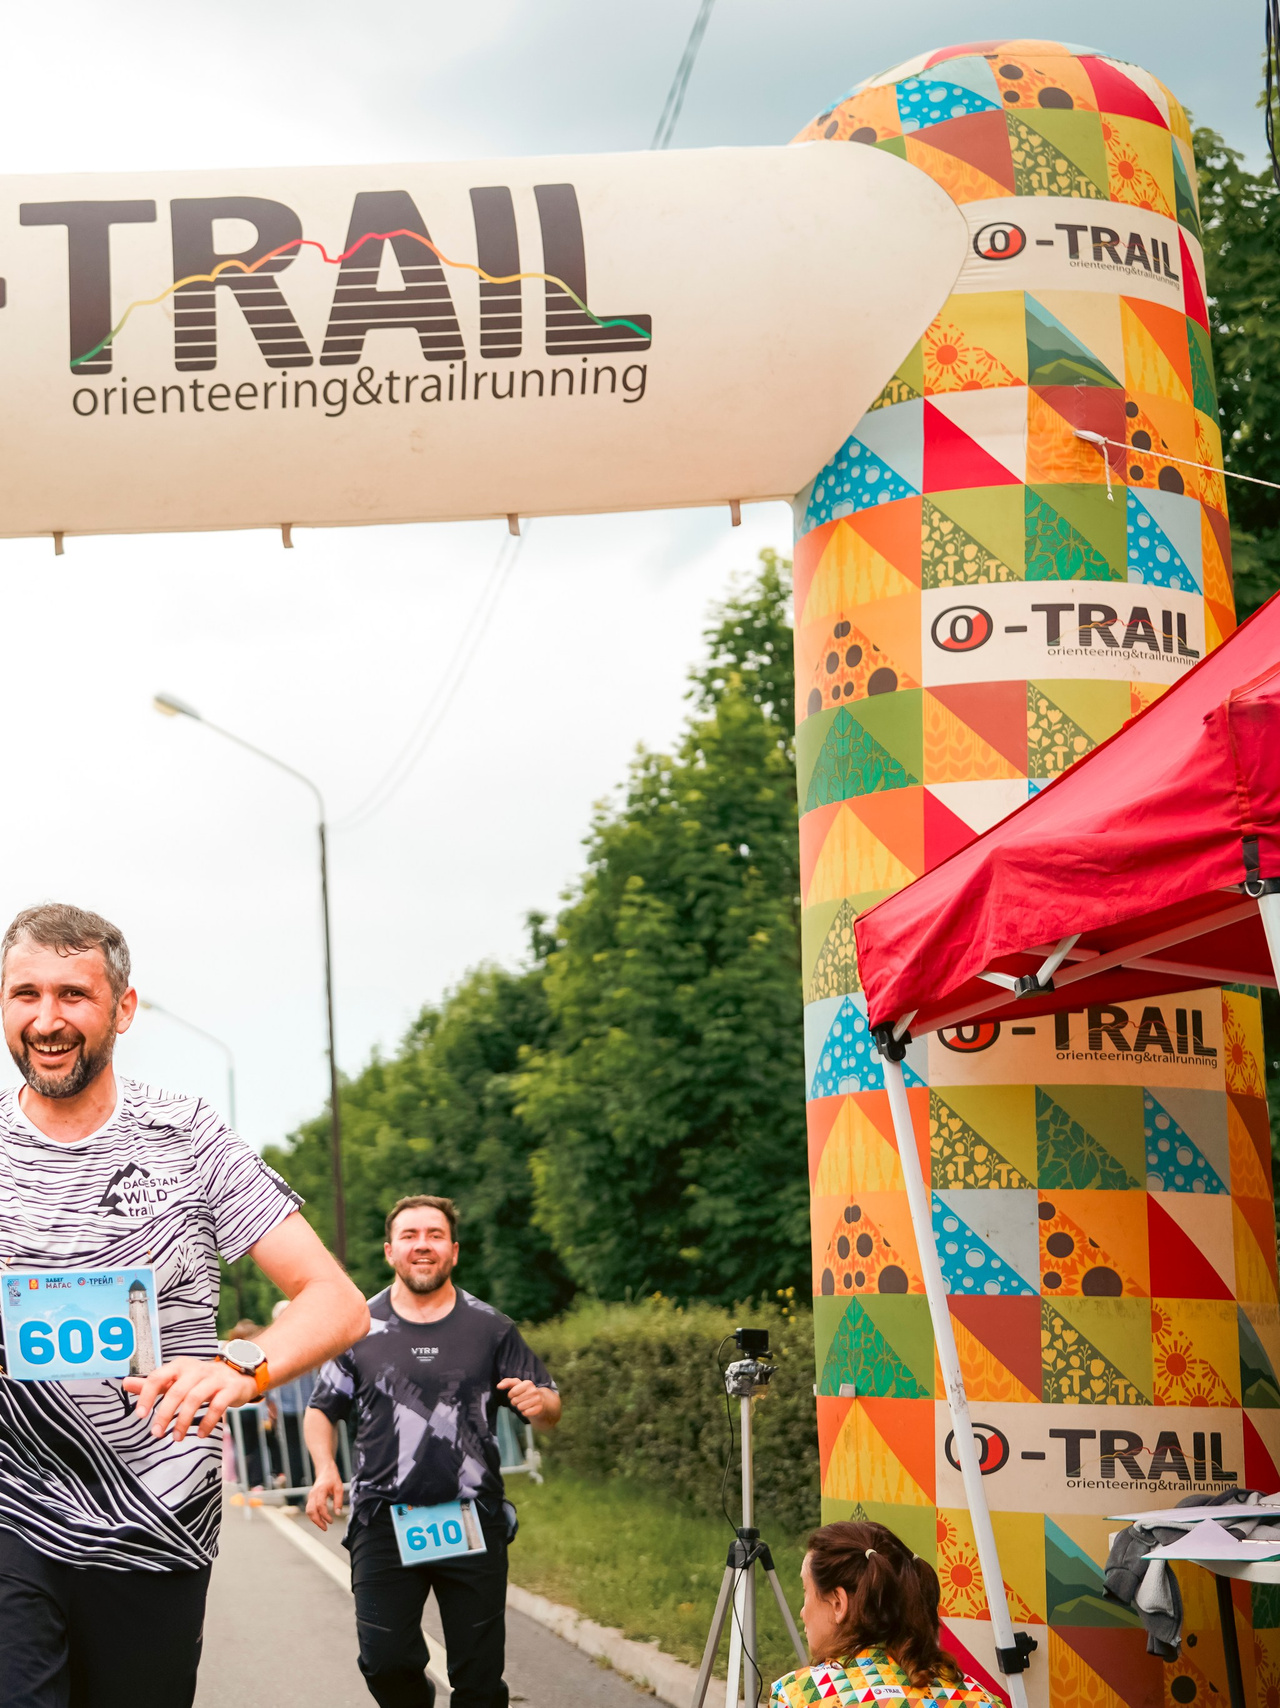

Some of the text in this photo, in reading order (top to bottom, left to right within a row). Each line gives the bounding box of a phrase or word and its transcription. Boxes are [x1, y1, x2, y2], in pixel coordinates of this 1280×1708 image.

[1069, 260, 1180, 290] orienteering&trailrunning
[72, 360, 650, 418] orienteering&trailrunning
[1056, 1049, 1218, 1069] orienteering&trailrunning
[123, 1176, 179, 1190] DAGESTAN
[123, 1189, 168, 1205] WILD
[128, 1204, 154, 1217] trail
[19, 1317, 134, 1365] 609
[406, 1519, 462, 1551] 610
